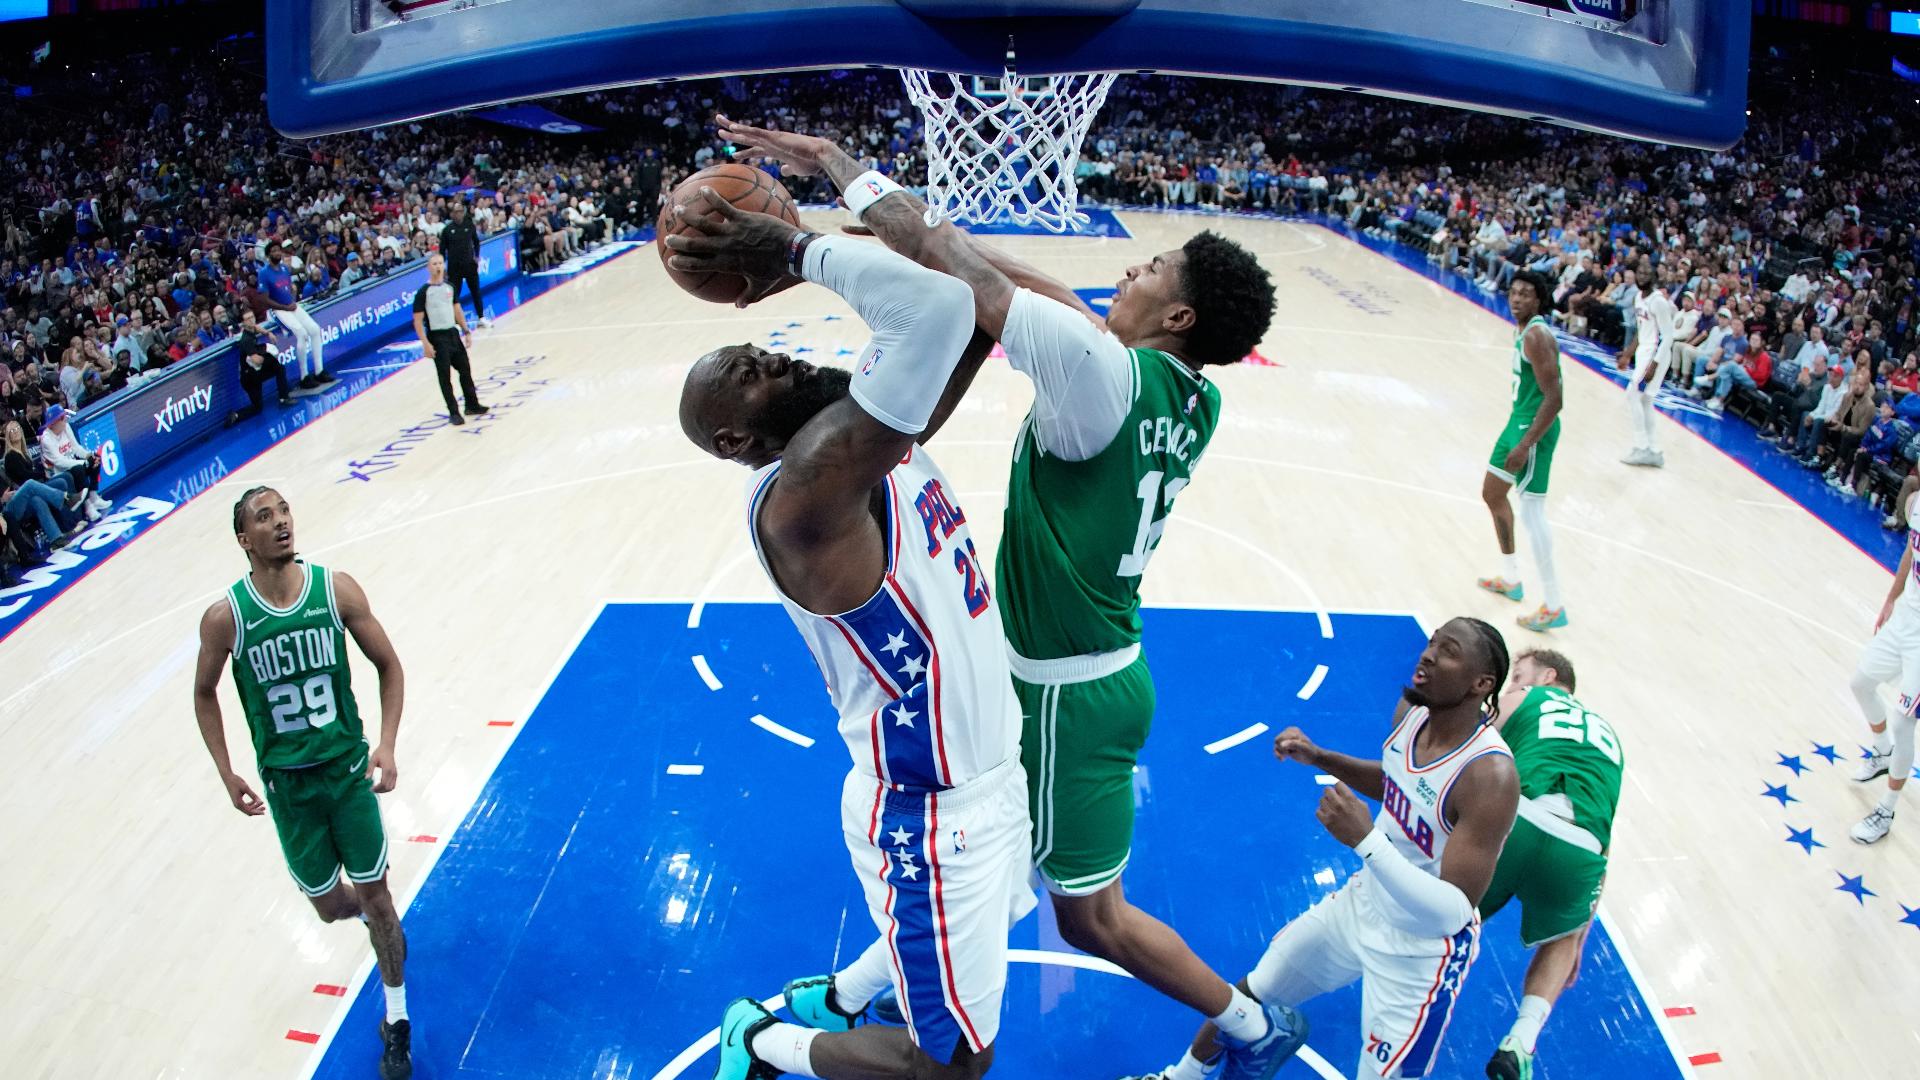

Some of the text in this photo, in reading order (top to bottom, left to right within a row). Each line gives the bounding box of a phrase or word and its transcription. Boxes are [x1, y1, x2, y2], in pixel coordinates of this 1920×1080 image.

[277, 345, 297, 365] ost
[366, 306, 375, 324] 5
[154, 385, 213, 434] xfinity
[247, 626, 337, 684] BOSTON
[266, 673, 338, 734] 29
[1366, 1031, 1392, 1064] 76
